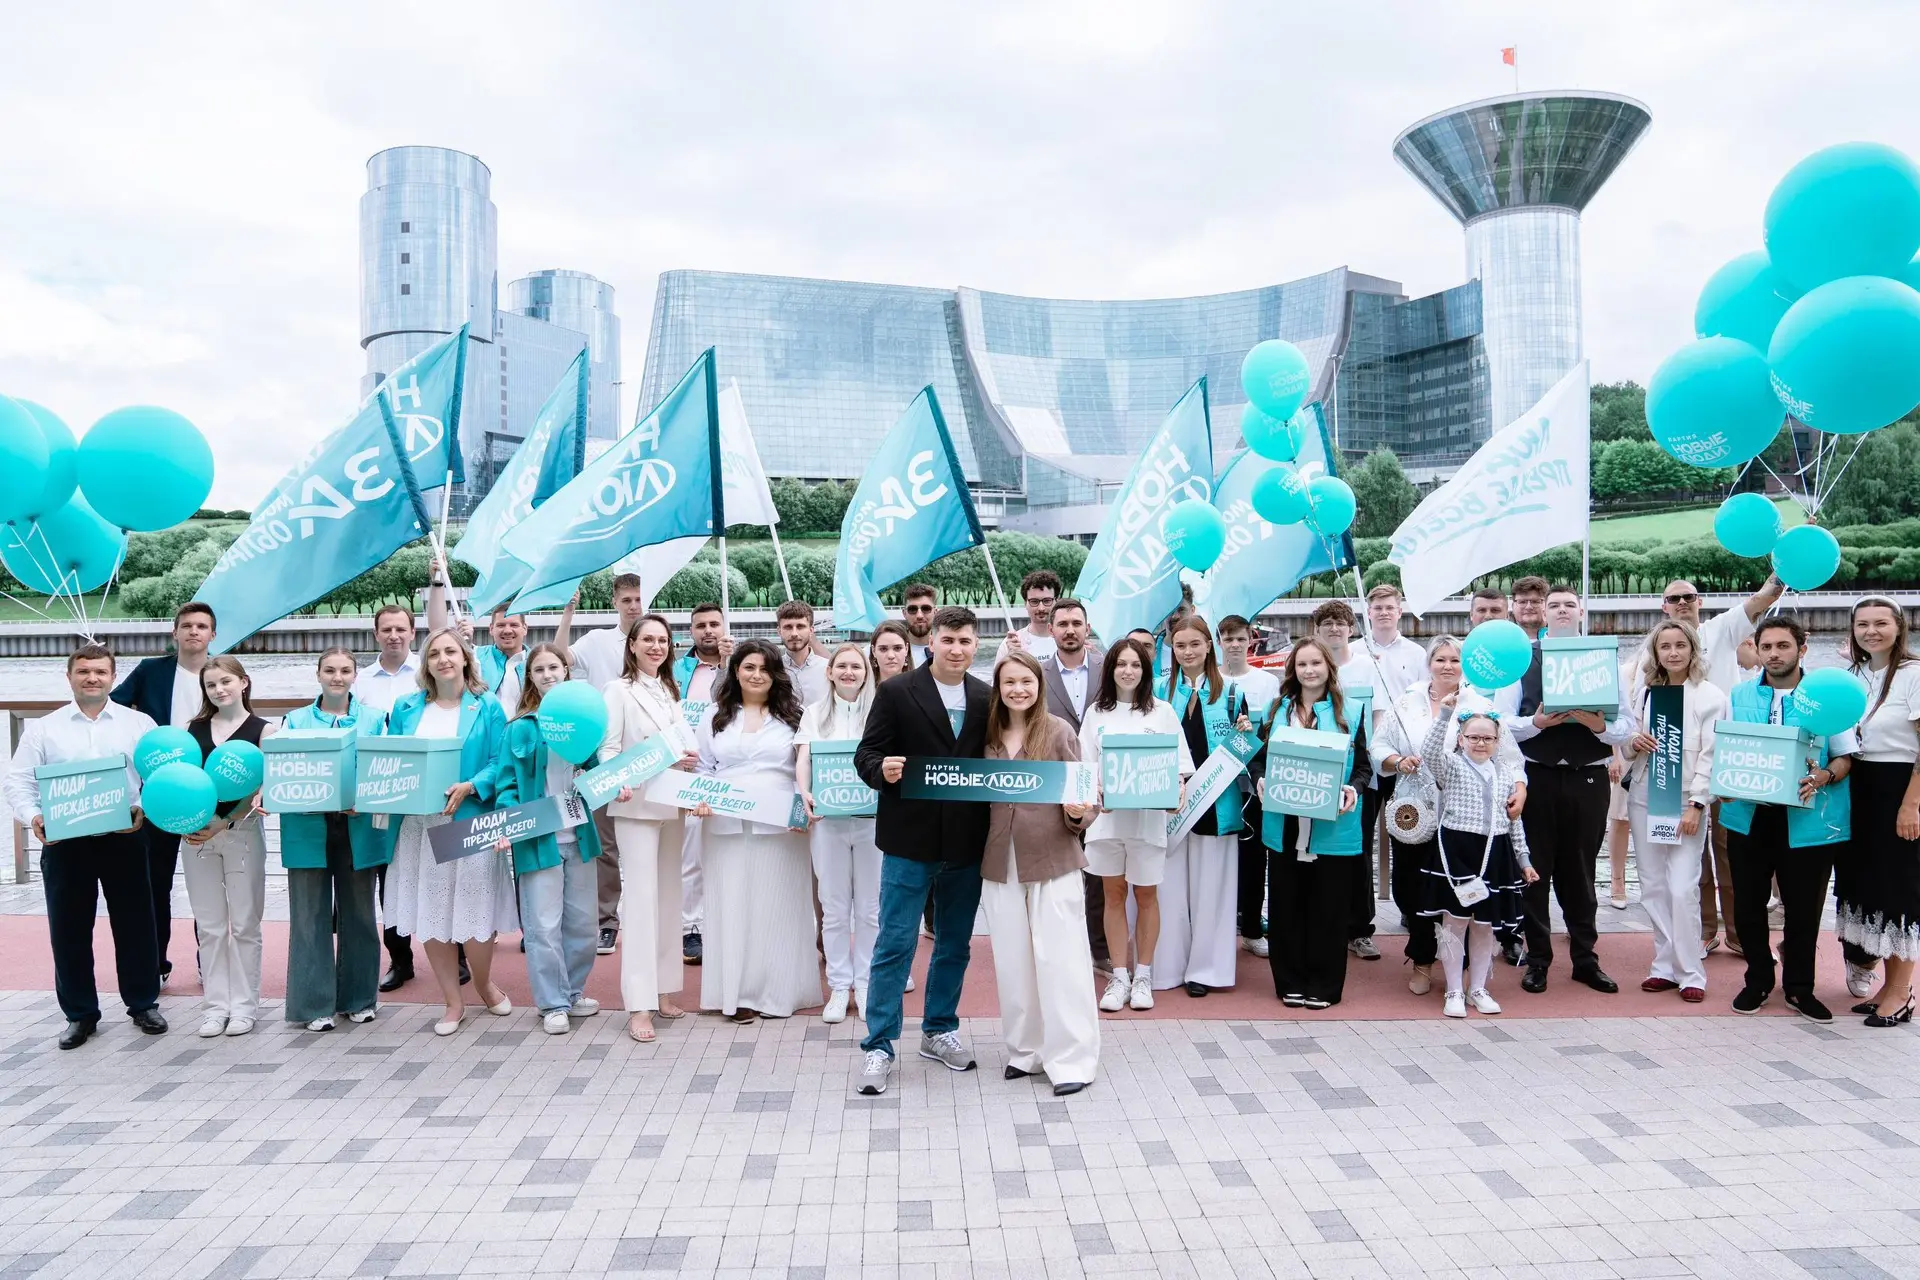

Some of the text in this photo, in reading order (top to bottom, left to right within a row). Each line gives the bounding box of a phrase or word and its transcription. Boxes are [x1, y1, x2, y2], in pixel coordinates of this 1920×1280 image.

[1670, 431, 1728, 455] НОВЫЕ
[1543, 656, 1575, 695] ЗА
[1213, 722, 1232, 730] НОВ
[1657, 714, 1667, 790] ПРЕЖДЕ ВСЕГО!
[1668, 724, 1682, 764] ЛЮДИ
[1723, 737, 1762, 747] ПАРТИЯ
[144, 748, 186, 770] НОВЫЕ
[220, 755, 256, 780] НОВЫЕ
[269, 761, 333, 777] НОВЫЕ
[368, 756, 401, 777] ЛЮДИ
[817, 757, 854, 765] ПАРТИЯ
[925, 764, 960, 772] ПАРТИЯ
[1272, 756, 1310, 768] ПАРТИЯ
[1719, 750, 1786, 770] НОВЫЕ
[214, 766, 246, 786] ЛЮДИ
[587, 770, 610, 786] ПАРТИЯ
[591, 750, 663, 797] НОВЫЕ ЛЮДИ
[818, 768, 862, 784] НОВ
[925, 772, 1037, 789] НОВЫЕ ЛЮДИ
[1105, 752, 1137, 795] ЗА
[1271, 765, 1334, 788] НОВЫЕ
[1721, 771, 1777, 791] ЛЮДИ
[48, 777, 86, 801] ЛЮДИ
[271, 783, 328, 800] ЛЮДИ
[357, 774, 420, 798] ПРЕЖДЕ ВСЕГО!
[689, 776, 731, 793] ЛЮДИ
[50, 787, 125, 821] ПРЕЖДЕ ВСЕГО!
[676, 789, 756, 812] ПРЕЖДЕ ВСЕГО!
[821, 787, 875, 805] ЛЮДИ
[1167, 812, 1183, 836] ССИЯ
[1188, 789, 1202, 810] ДЛЯ
[1200, 764, 1225, 792] ЖИЗНИ
[1273, 785, 1326, 805] ЛЮДИ
[470, 811, 507, 833] ЛЮДИ
[1655, 824, 1676, 832] ЛЮДИ
[463, 817, 537, 849] ПРЕЖДЕ ВСЕГО!
